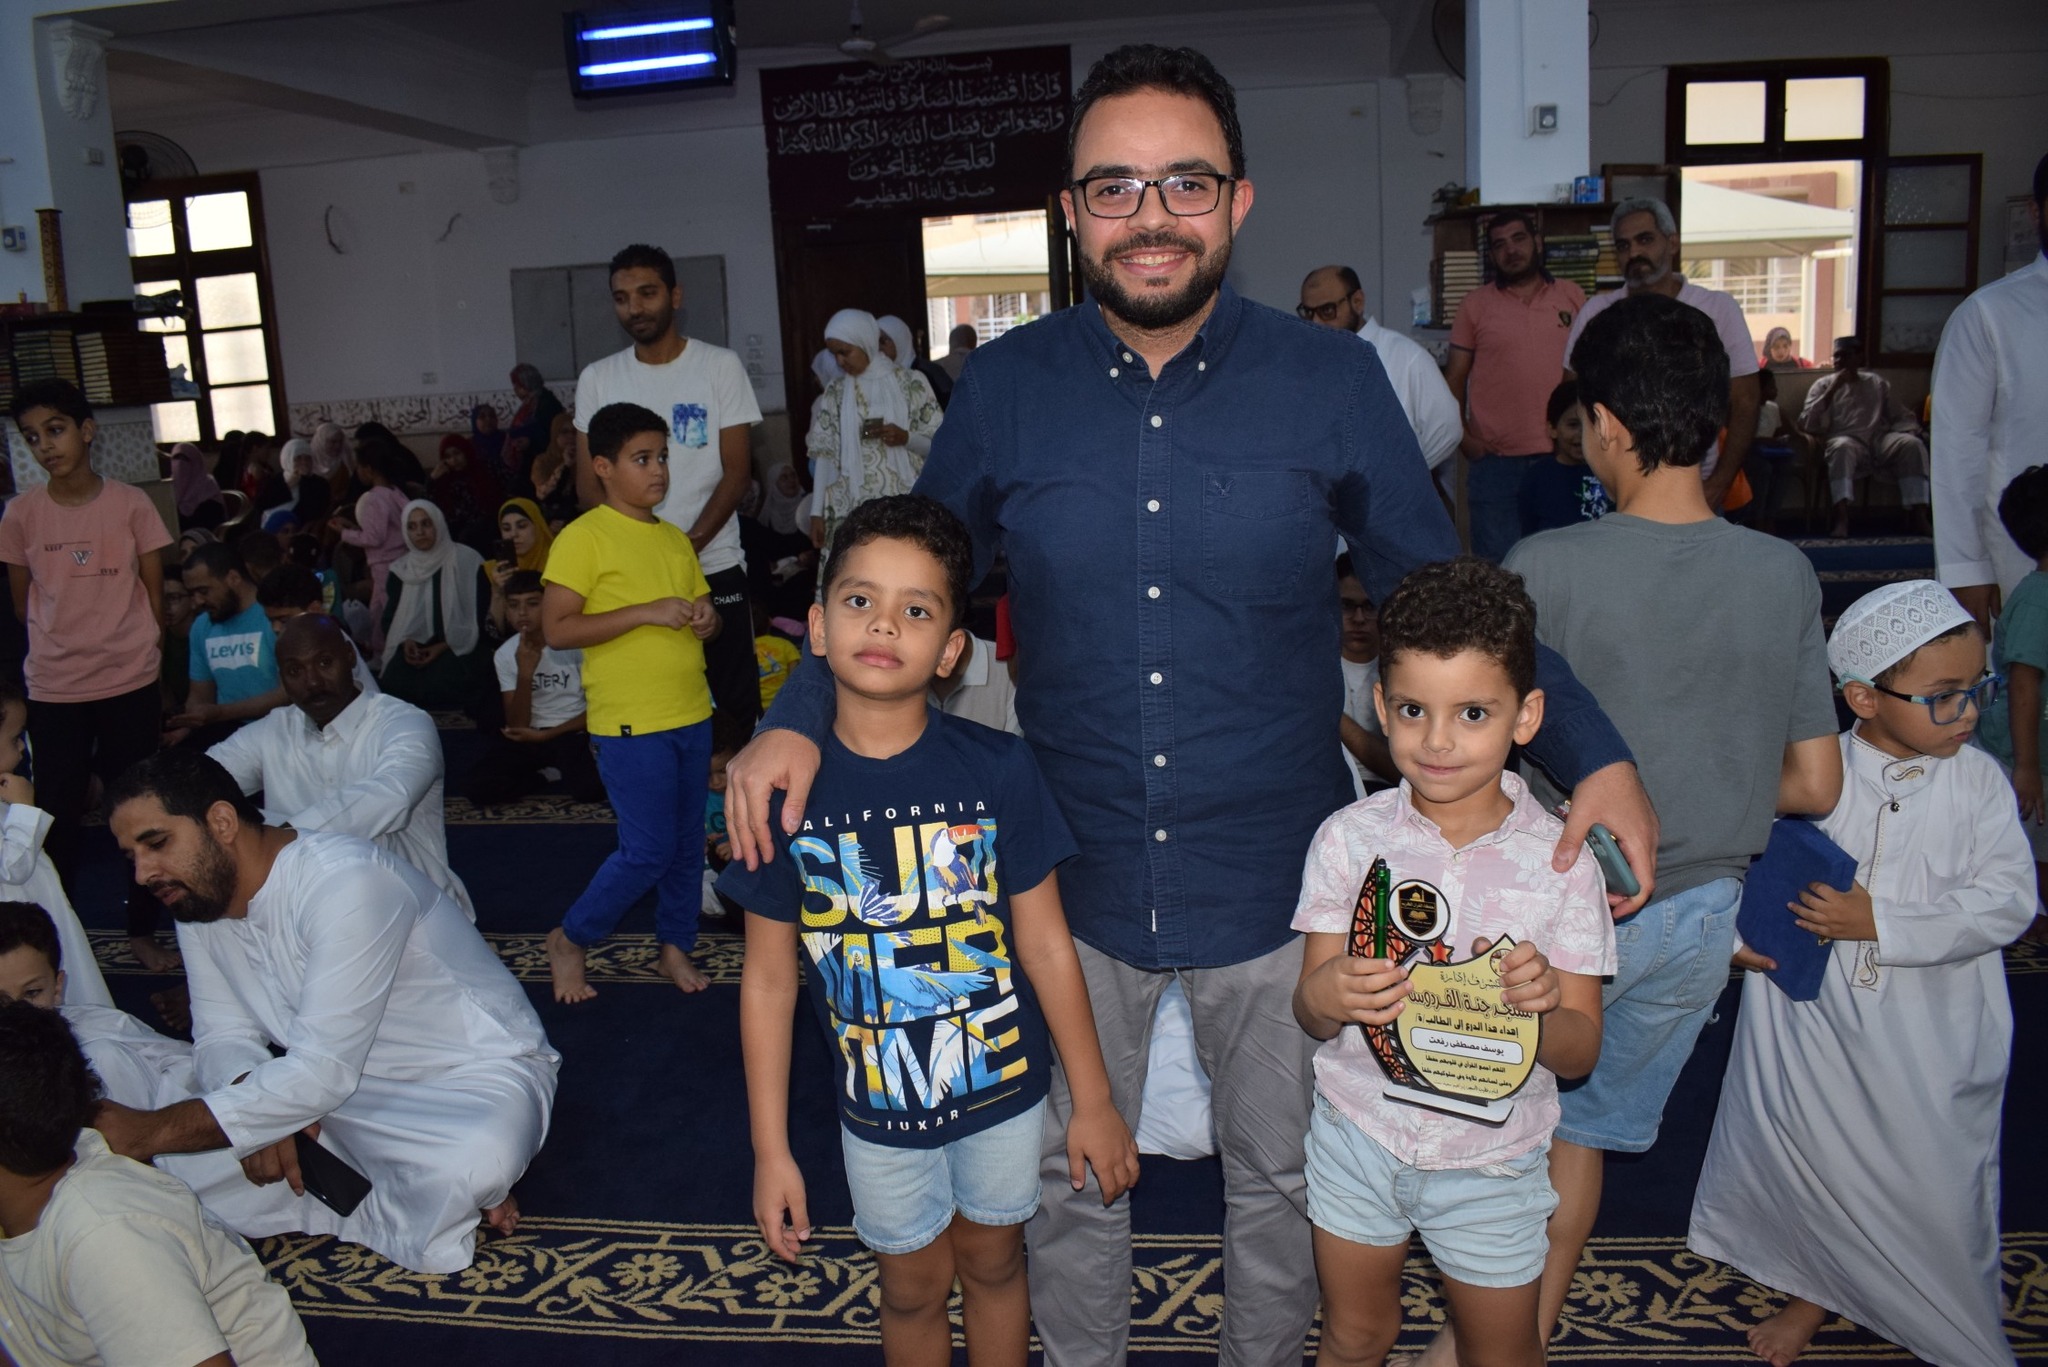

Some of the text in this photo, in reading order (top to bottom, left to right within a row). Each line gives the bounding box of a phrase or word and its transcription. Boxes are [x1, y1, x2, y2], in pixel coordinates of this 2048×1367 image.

[713, 592, 744, 606] CHANEL
[803, 800, 986, 831] ALIFORNIA
[1463, 993, 1491, 1017] جنة
[1428, 1036, 1449, 1047] رفعت
[1481, 1044, 1504, 1057] يوسف
